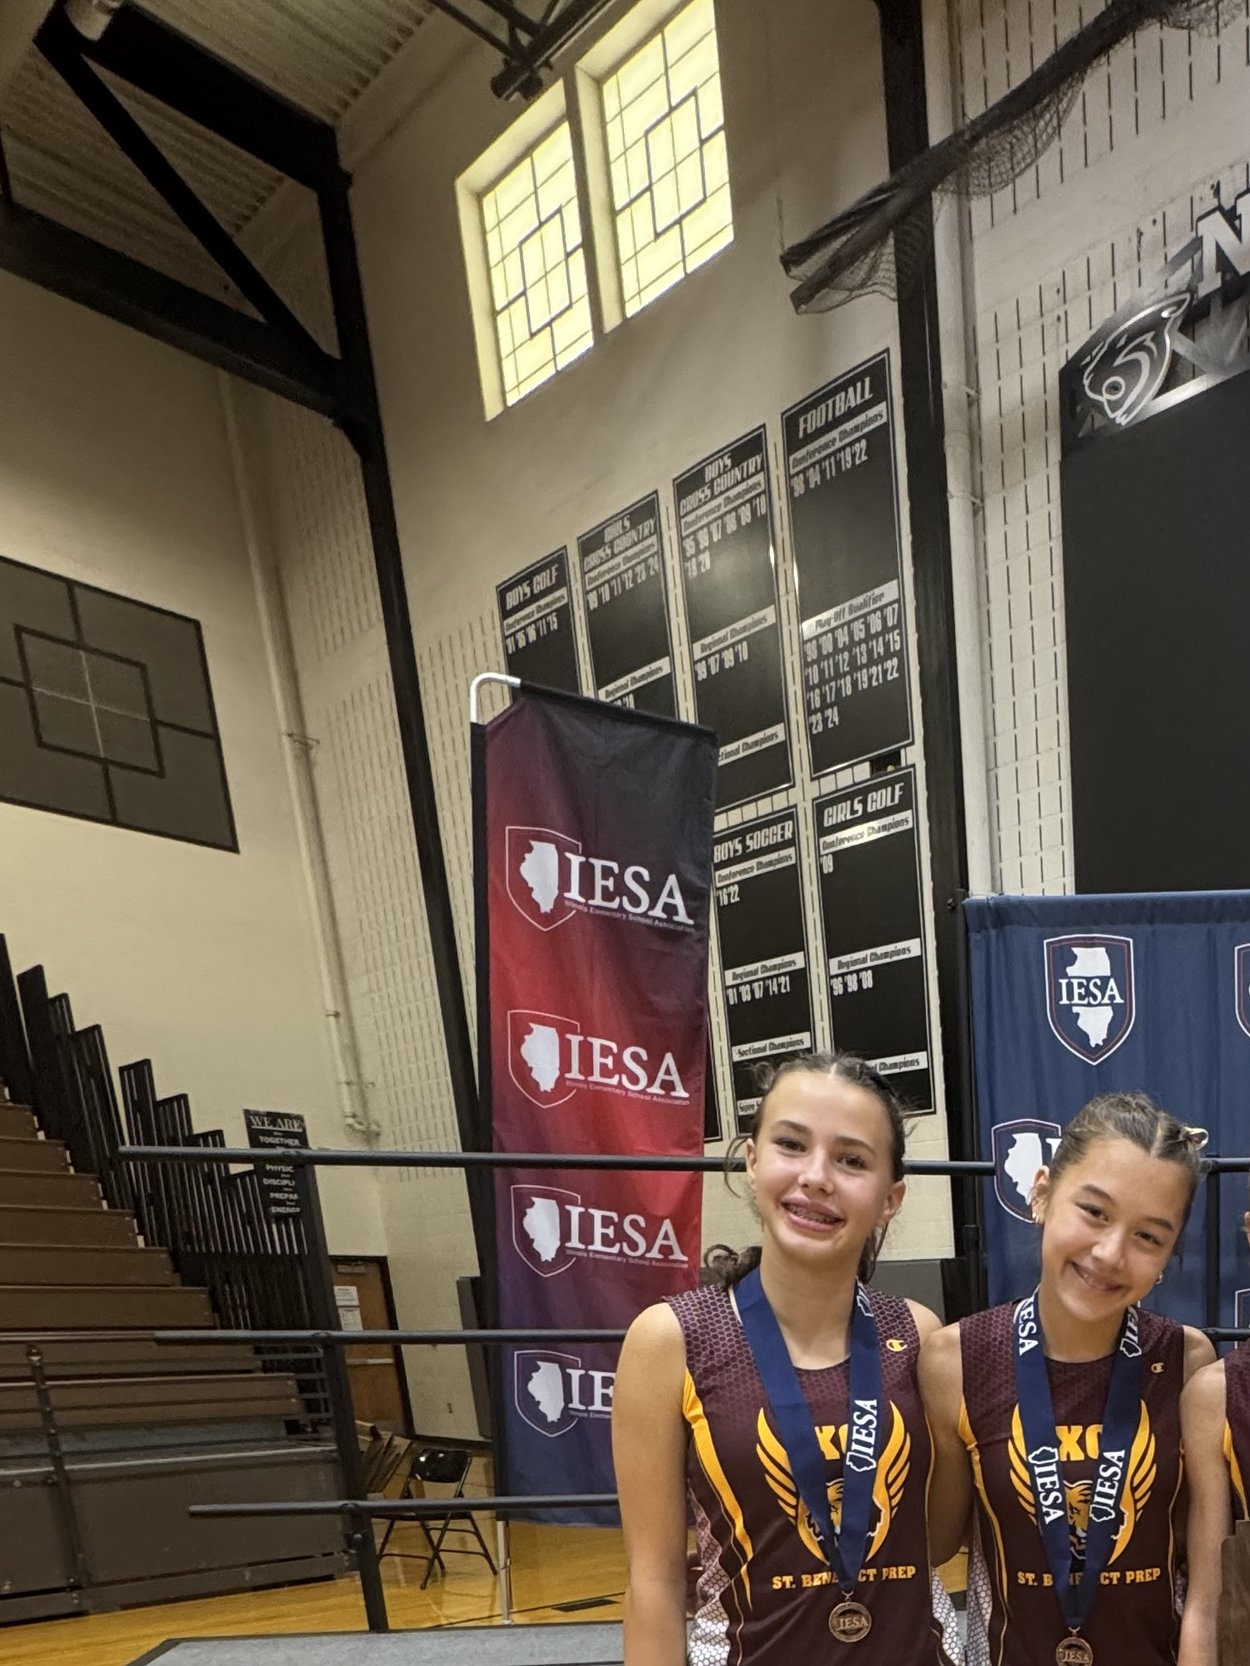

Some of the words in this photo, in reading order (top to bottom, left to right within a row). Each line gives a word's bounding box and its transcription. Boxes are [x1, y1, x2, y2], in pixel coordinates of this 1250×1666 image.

[798, 377, 874, 439] FOOTBALL
[838, 409, 884, 442] Champions
[704, 452, 732, 483] BOYS
[822, 455, 836, 480] '11
[836, 446, 852, 472] '19
[852, 438, 868, 466] '22
[680, 483, 712, 517] CROSS
[713, 452, 763, 496] COUNTRY
[613, 516, 656, 555] COUNTRY
[505, 580, 531, 610] BOYS
[533, 564, 559, 595] GOLF
[834, 625, 850, 649] '04
[851, 617, 866, 642] '05
[866, 610, 882, 635] '06
[883, 602, 899, 628] '07
[735, 640, 749, 663] '10
[805, 664, 819, 686] '10
[820, 656, 835, 680] '11
[835, 650, 850, 674] '12
[852, 643, 868, 666] '13
[868, 635, 884, 659] '14
[885, 629, 901, 653] '15
[806, 688, 821, 711] '16
[822, 681, 837, 704] '17
[837, 674, 852, 698] '18
[853, 668, 869, 692] '19
[868, 661, 883, 688] '21
[883, 656, 900, 681] '22
[808, 711, 823, 735] '23
[824, 705, 840, 729] '24
[741, 731, 779, 754] Champions
[823, 796, 864, 828] GIRLS
[866, 782, 905, 813] GOLF
[713, 836, 743, 864] BOYS
[745, 820, 794, 853] SOCCER
[821, 830, 865, 852] Conference
[866, 816, 910, 837] Champions
[717, 864, 755, 884] Conference
[755, 852, 793, 872] Champions
[820, 853, 834, 875] '09
[563, 852, 695, 925] IESA
[727, 883, 741, 904] '22
[731, 964, 759, 982] Regional
[760, 958, 797, 975] Champions
[837, 953, 868, 971] Regional
[869, 945, 912, 963] Champions
[726, 987, 738, 1005] '01
[751, 981, 764, 999] '07
[764, 977, 778, 996] '14
[777, 975, 791, 993] '21
[859, 969, 874, 990] '08
[1058, 977, 1125, 1005] IESA
[737, 1042, 768, 1058] Sectional
[768, 1036, 805, 1052] Champions
[564, 1033, 690, 1098] IESA
[878, 1057, 920, 1072] Champions
[250, 1115, 273, 1128] WE
[276, 1118, 303, 1130] ARE
[259, 1135, 301, 1146] TOGETHER
[564, 1204, 689, 1262] IESA
[565, 1368, 617, 1412] IE
[851, 1399, 878, 1457] IESA
[1033, 1462, 1065, 1525] IESA
[1094, 1449, 1126, 1507] IESA
[771, 1575, 797, 1591] ST.
[882, 1565, 917, 1581] PREP
[1017, 1571, 1038, 1586] ST.
[1125, 1567, 1161, 1584] PREP
[839, 1616, 869, 1629] IESA
[1063, 1650, 1090, 1661] IESA
